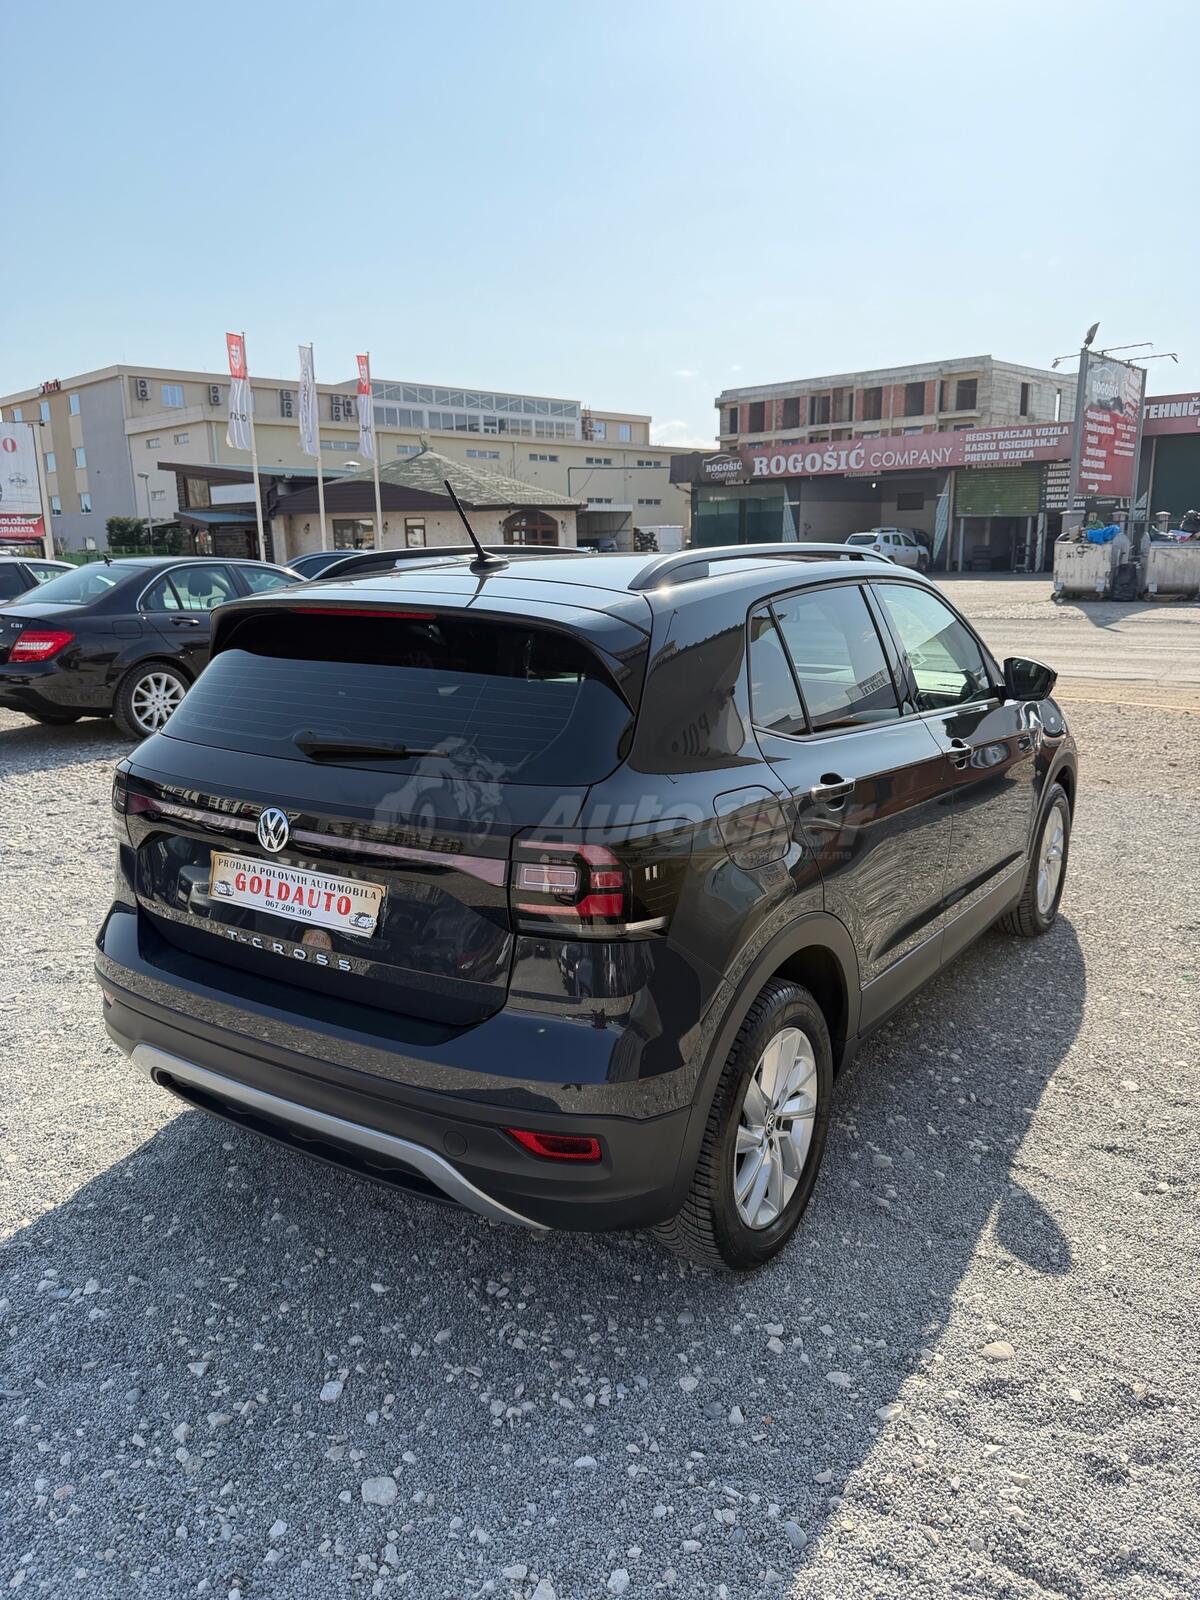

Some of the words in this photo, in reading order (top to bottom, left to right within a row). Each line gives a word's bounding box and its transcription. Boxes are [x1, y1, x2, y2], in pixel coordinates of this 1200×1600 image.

[966, 430, 1032, 442] REGISTRACIJA
[1036, 426, 1069, 436] VOZILA
[965, 442, 996, 452] KASKO
[999, 438, 1059, 450] OSIGURANJE
[753, 443, 865, 476] ROGOŠIĆ
[870, 449, 952, 467] COMPANY
[964, 453, 1000, 462] PREVOD
[1003, 450, 1035, 460] VOZILA
[706, 461, 743, 473] ROGOŠIĆ
[217, 858, 258, 875] PRODAJA
[258, 867, 308, 886] POLOVNIH
[310, 876, 378, 901] AUTOMOBILA
[234, 872, 353, 917] GOLDAUTO
[265, 899, 280, 910] 067
[280, 904, 297, 914] 209
[296, 908, 313, 918] 309
[226, 929, 353, 973] T-CROSS
